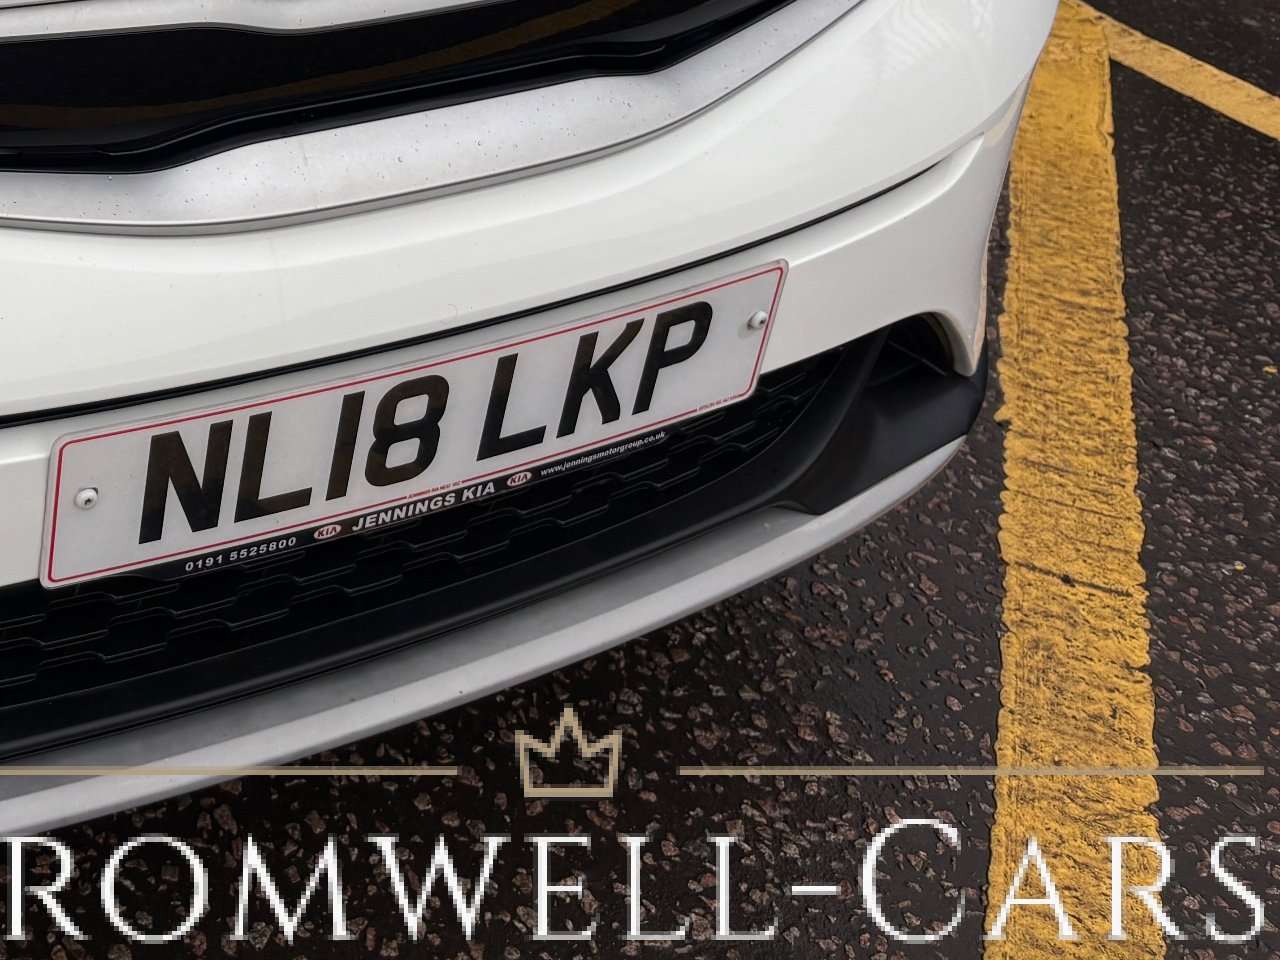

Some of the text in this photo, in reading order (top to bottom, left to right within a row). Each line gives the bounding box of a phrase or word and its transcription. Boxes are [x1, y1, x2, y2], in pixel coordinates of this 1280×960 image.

[138, 301, 713, 545] NL18 LKP
[185, 554, 223, 571] 0191
[229, 536, 297, 561] 5525800
[316, 525, 339, 538] KIA
[352, 492, 456, 532] JENNINGS
[461, 481, 496, 502] KIA
[508, 473, 529, 486] KIA
[540, 431, 667, 476] www.jenningsmotorgroup.co.uk
